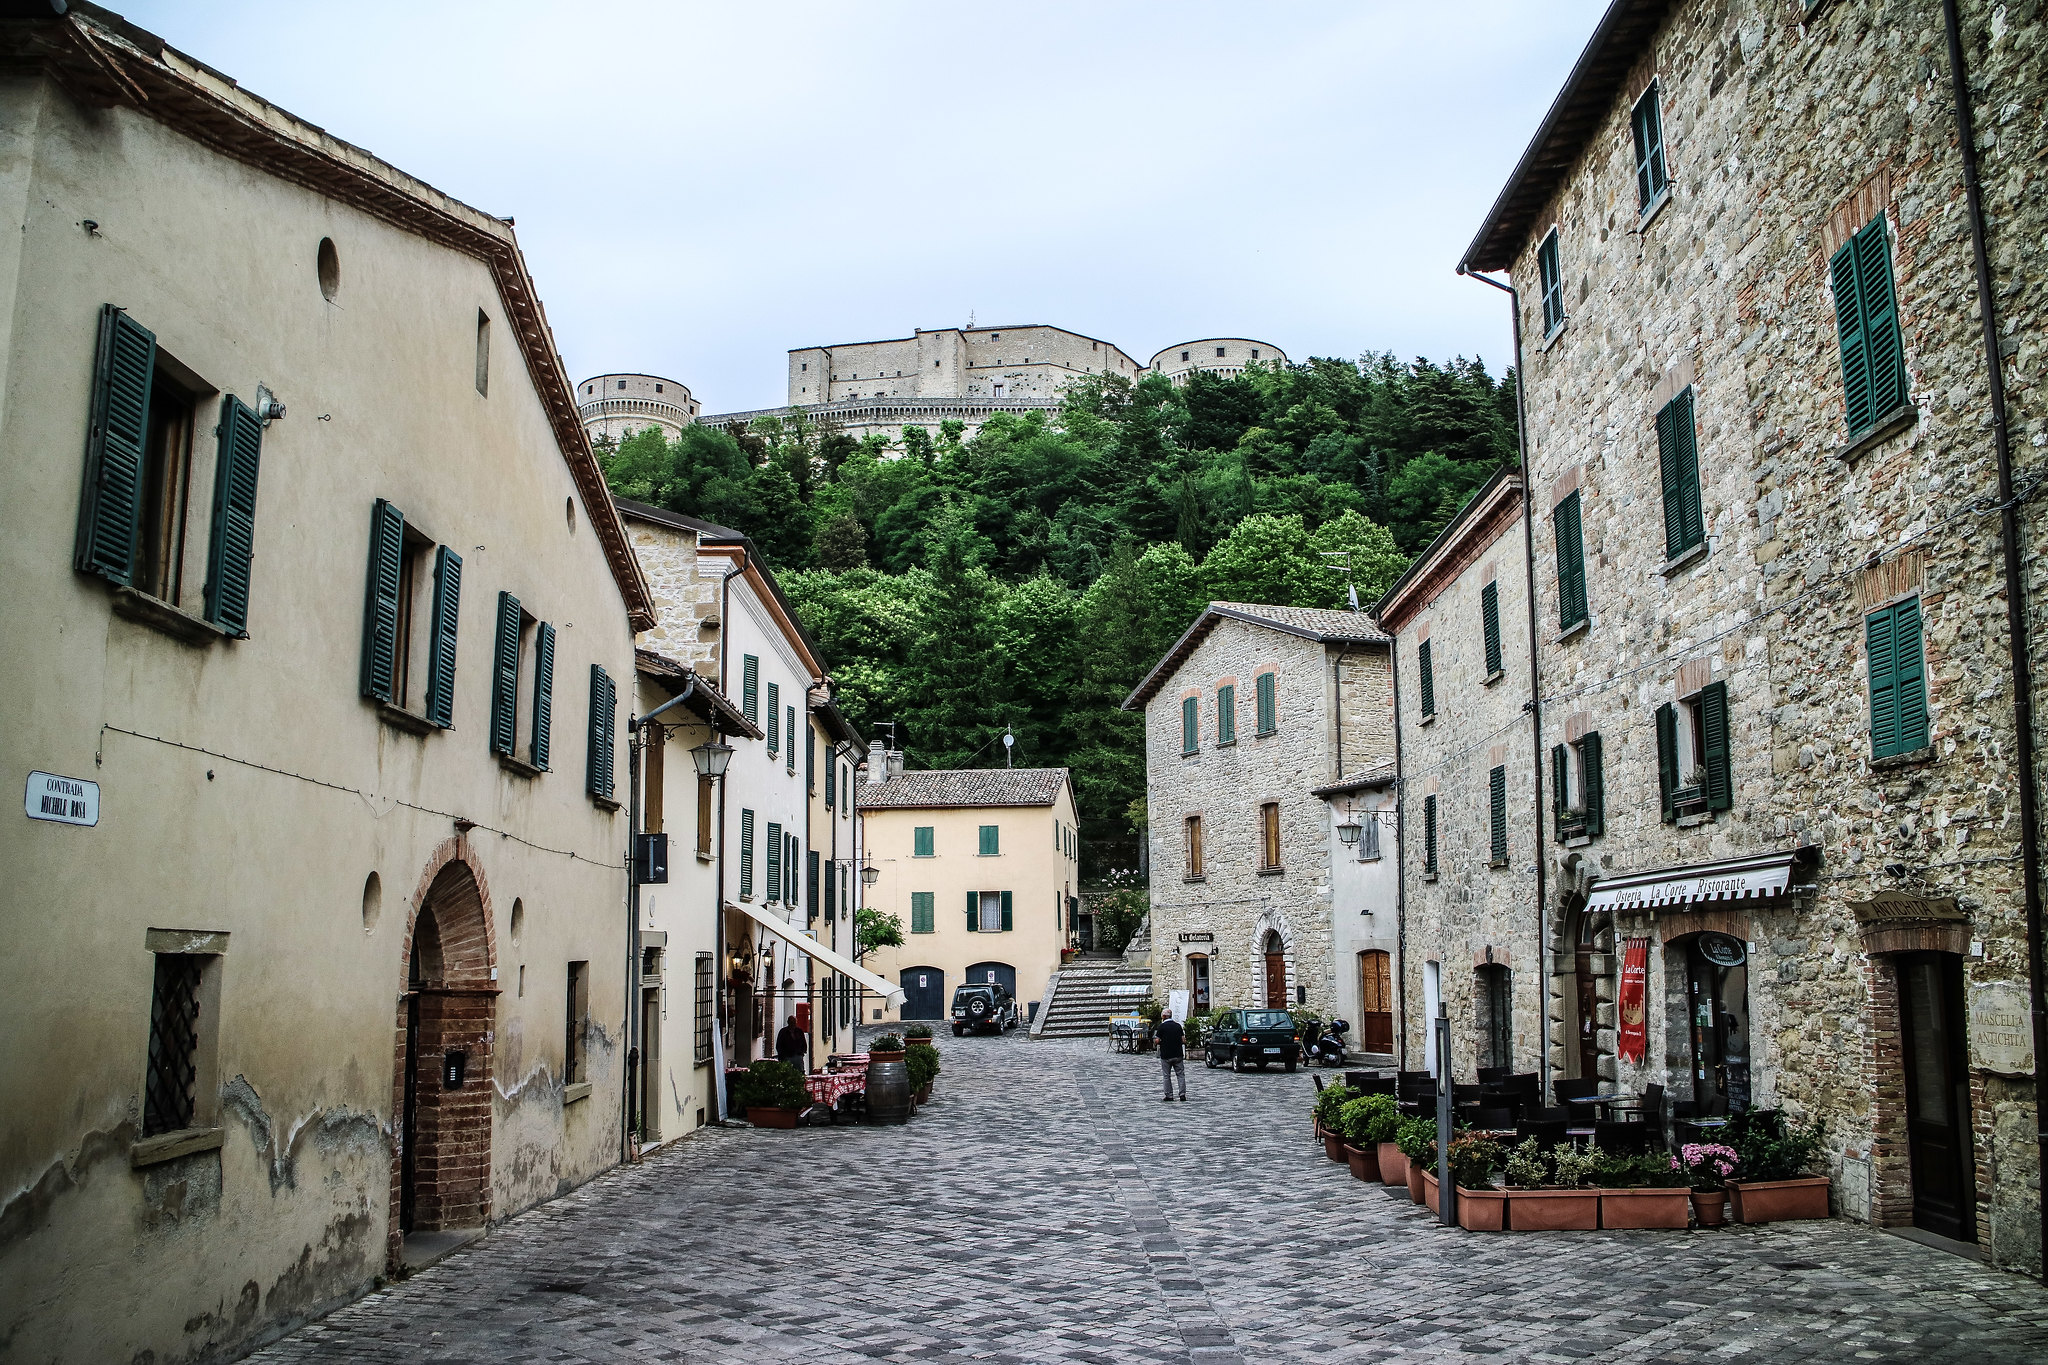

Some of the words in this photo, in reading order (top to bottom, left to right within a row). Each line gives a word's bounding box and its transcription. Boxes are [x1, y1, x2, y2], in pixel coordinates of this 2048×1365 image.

[47, 779, 83, 797] CONTRADA
[41, 795, 67, 816] MICHELE
[71, 801, 86, 819] ROSA
[1616, 889, 1642, 903] Osteria
[1651, 885, 1661, 899] La
[1665, 883, 1687, 897] Corte
[1697, 877, 1746, 893] Ristorante
[1975, 1012, 2025, 1028] MASCELLA
